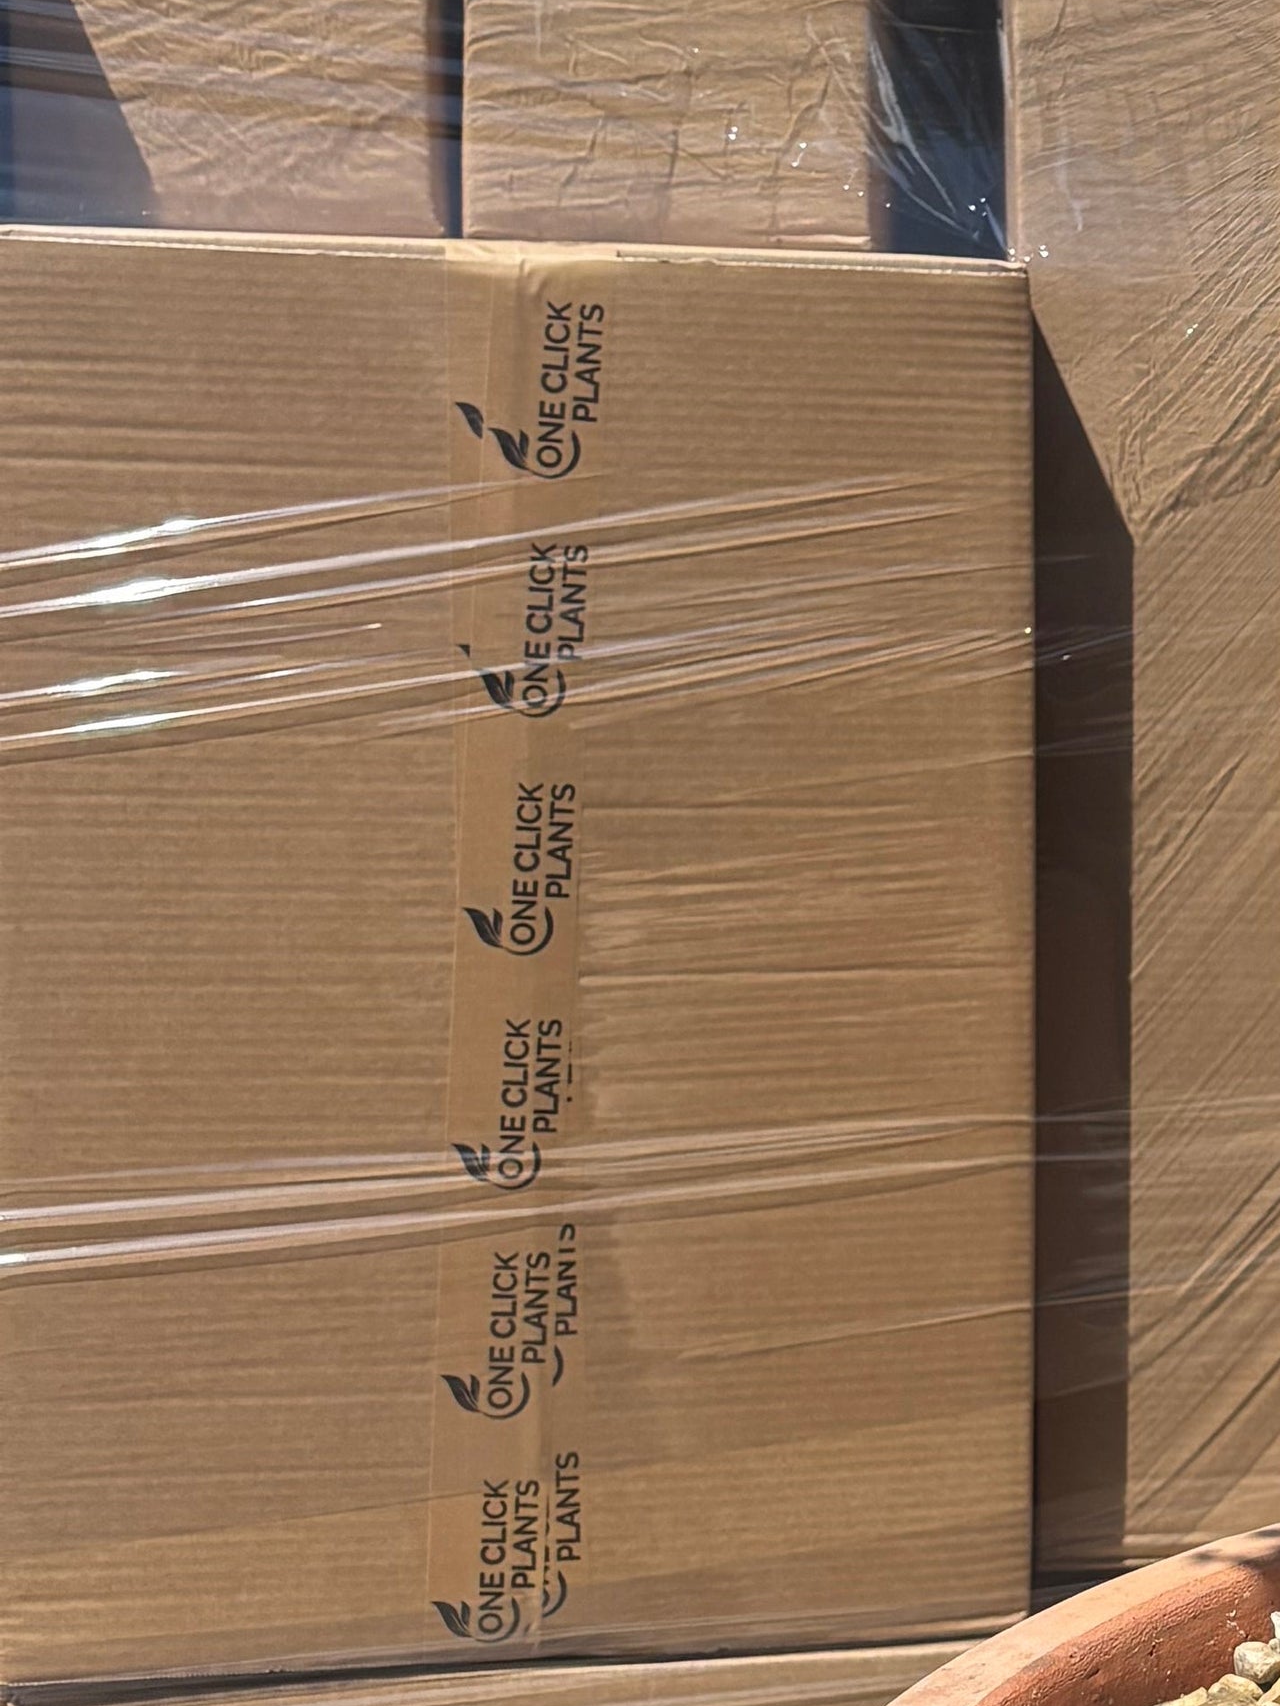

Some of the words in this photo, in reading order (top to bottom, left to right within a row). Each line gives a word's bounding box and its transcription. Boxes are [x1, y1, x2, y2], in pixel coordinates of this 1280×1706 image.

[541, 301, 575, 391] CLICK
[572, 302, 605, 424] PLANTS
[536, 395, 568, 469] ONE
[526, 542, 559, 634] CLICK
[557, 543, 590, 662] PLANTS
[519, 635, 552, 706] ONE
[513, 781, 546, 874] CLICK
[544, 782, 577, 898] PLANTS
[509, 877, 541, 947] ONE
[502, 1017, 532, 1107] CLICK
[533, 1018, 563, 1134] PLANTS
[497, 1111, 528, 1179] ONE
[491, 1252, 521, 1340] CLICK
[521, 1251, 551, 1364] PLANTS
[487, 1343, 517, 1410] ONE
[480, 1479, 512, 1567] CLICK
[511, 1478, 542, 1589] PLANTS
[555, 1451, 581, 1562] PLANTS
[477, 1570, 506, 1636] ONE
